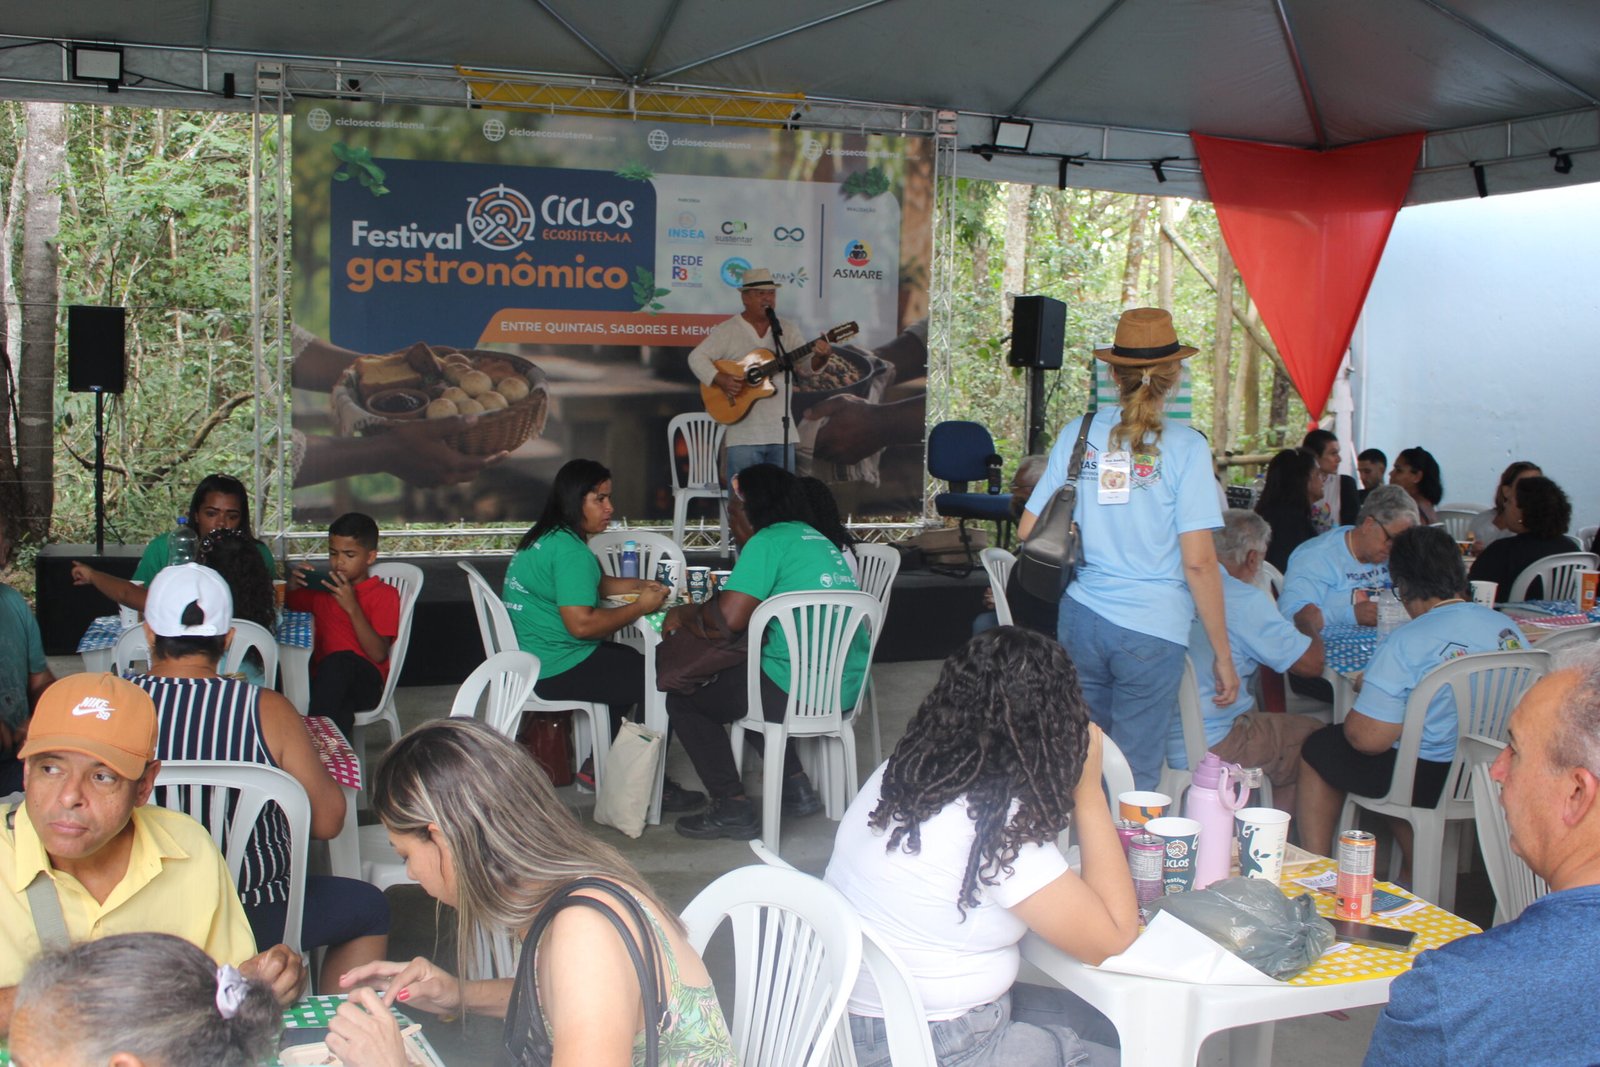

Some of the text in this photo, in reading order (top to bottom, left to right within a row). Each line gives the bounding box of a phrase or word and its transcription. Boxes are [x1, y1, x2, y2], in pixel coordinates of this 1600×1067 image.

[352, 220, 462, 250] Festival
[542, 229, 633, 243] ECOSSISTEMA
[667, 227, 705, 239] INSEA
[715, 235, 753, 244] sustentar
[672, 254, 704, 267] REDE
[346, 251, 629, 294] gastronômico
[833, 268, 883, 280] ASMARE
[501, 321, 542, 332] ENTRE
[545, 322, 607, 335] QUINTAIS,
[610, 323, 668, 335] SABORES
[670, 324, 678, 335] E
[79, 696, 110, 707] NIKE
[96, 711, 111, 721] SB
